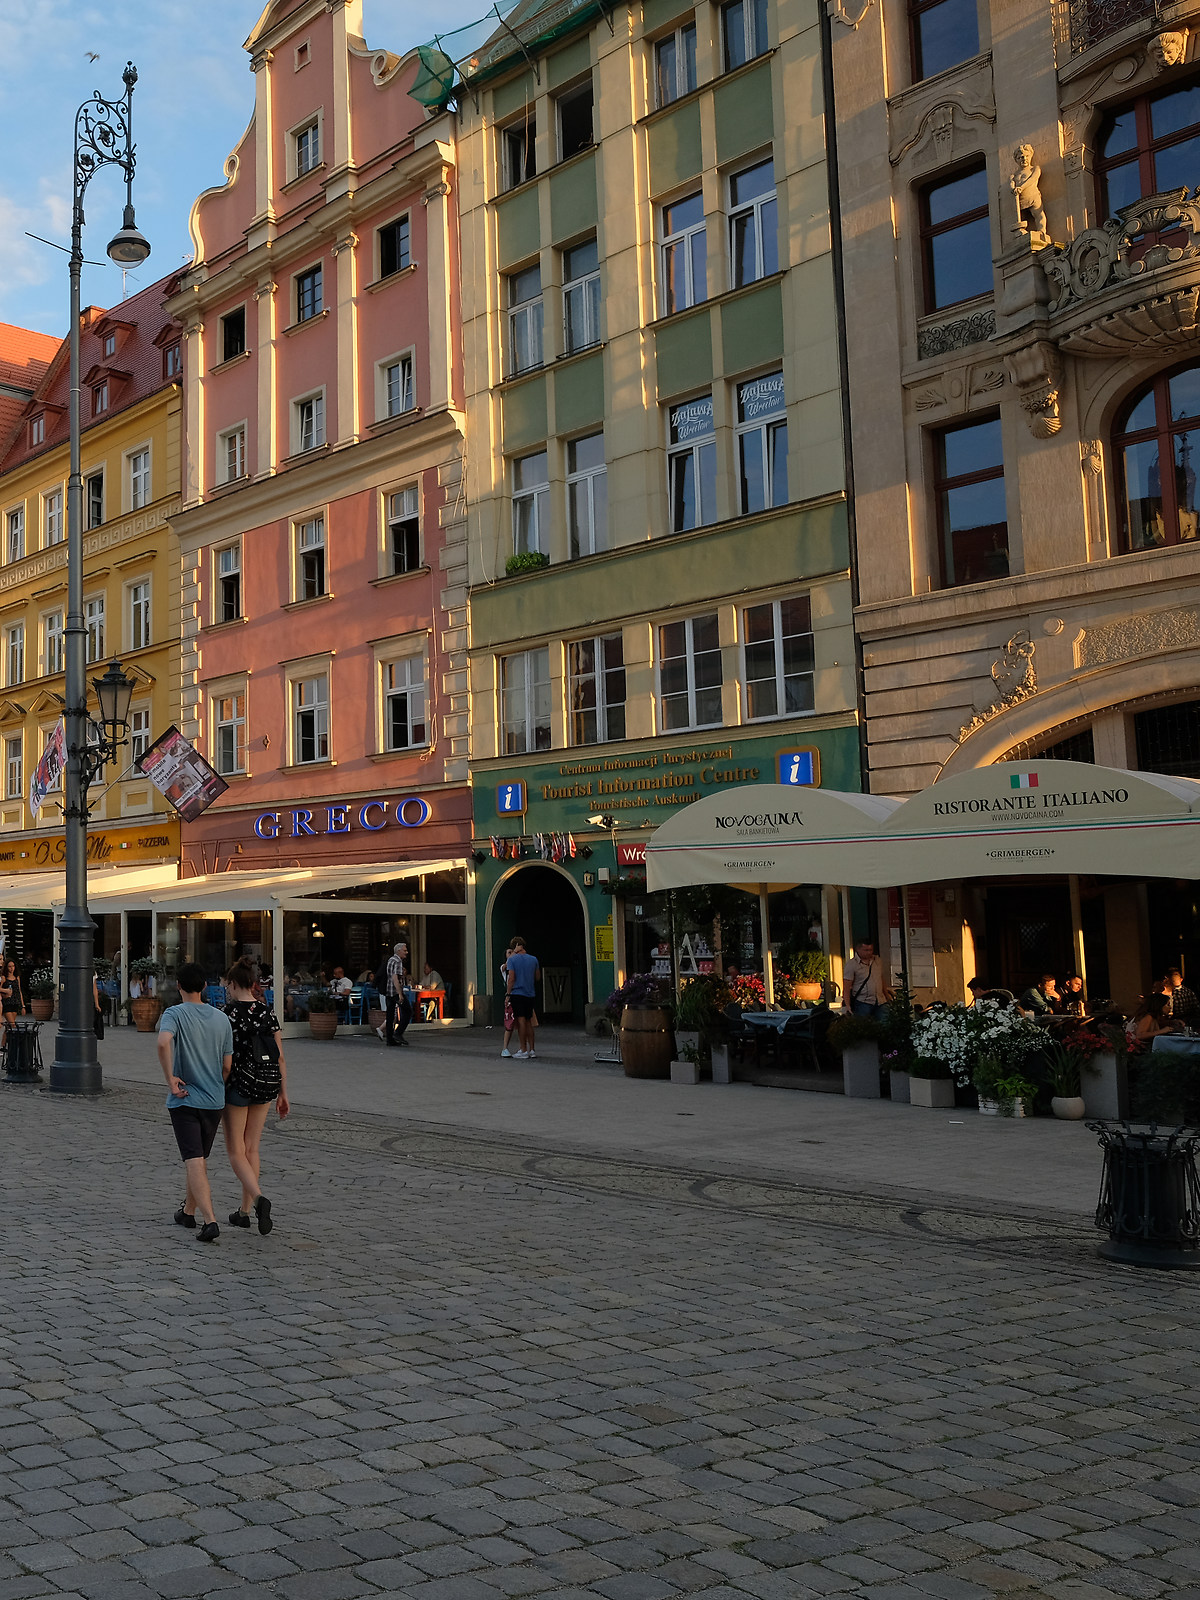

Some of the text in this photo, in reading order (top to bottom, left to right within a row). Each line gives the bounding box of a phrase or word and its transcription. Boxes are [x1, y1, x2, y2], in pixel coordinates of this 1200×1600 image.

[559, 745, 734, 776] Centrum Informacji Turystycznej
[540, 766, 760, 801] Tourist Information Centre
[589, 792, 700, 811] Touristische Auskunft
[934, 788, 1129, 815] RISTORANTE ITALIANO
[254, 797, 433, 840] GRECO
[715, 812, 803, 829] NOVOCAINA
[991, 809, 1064, 821] WWW.NOVOCAINA.COM
[137, 836, 170, 849] PIZZERIA
[990, 848, 1051, 858] GRIMBERGEN
[727, 860, 772, 868] GRIMBERGEN
